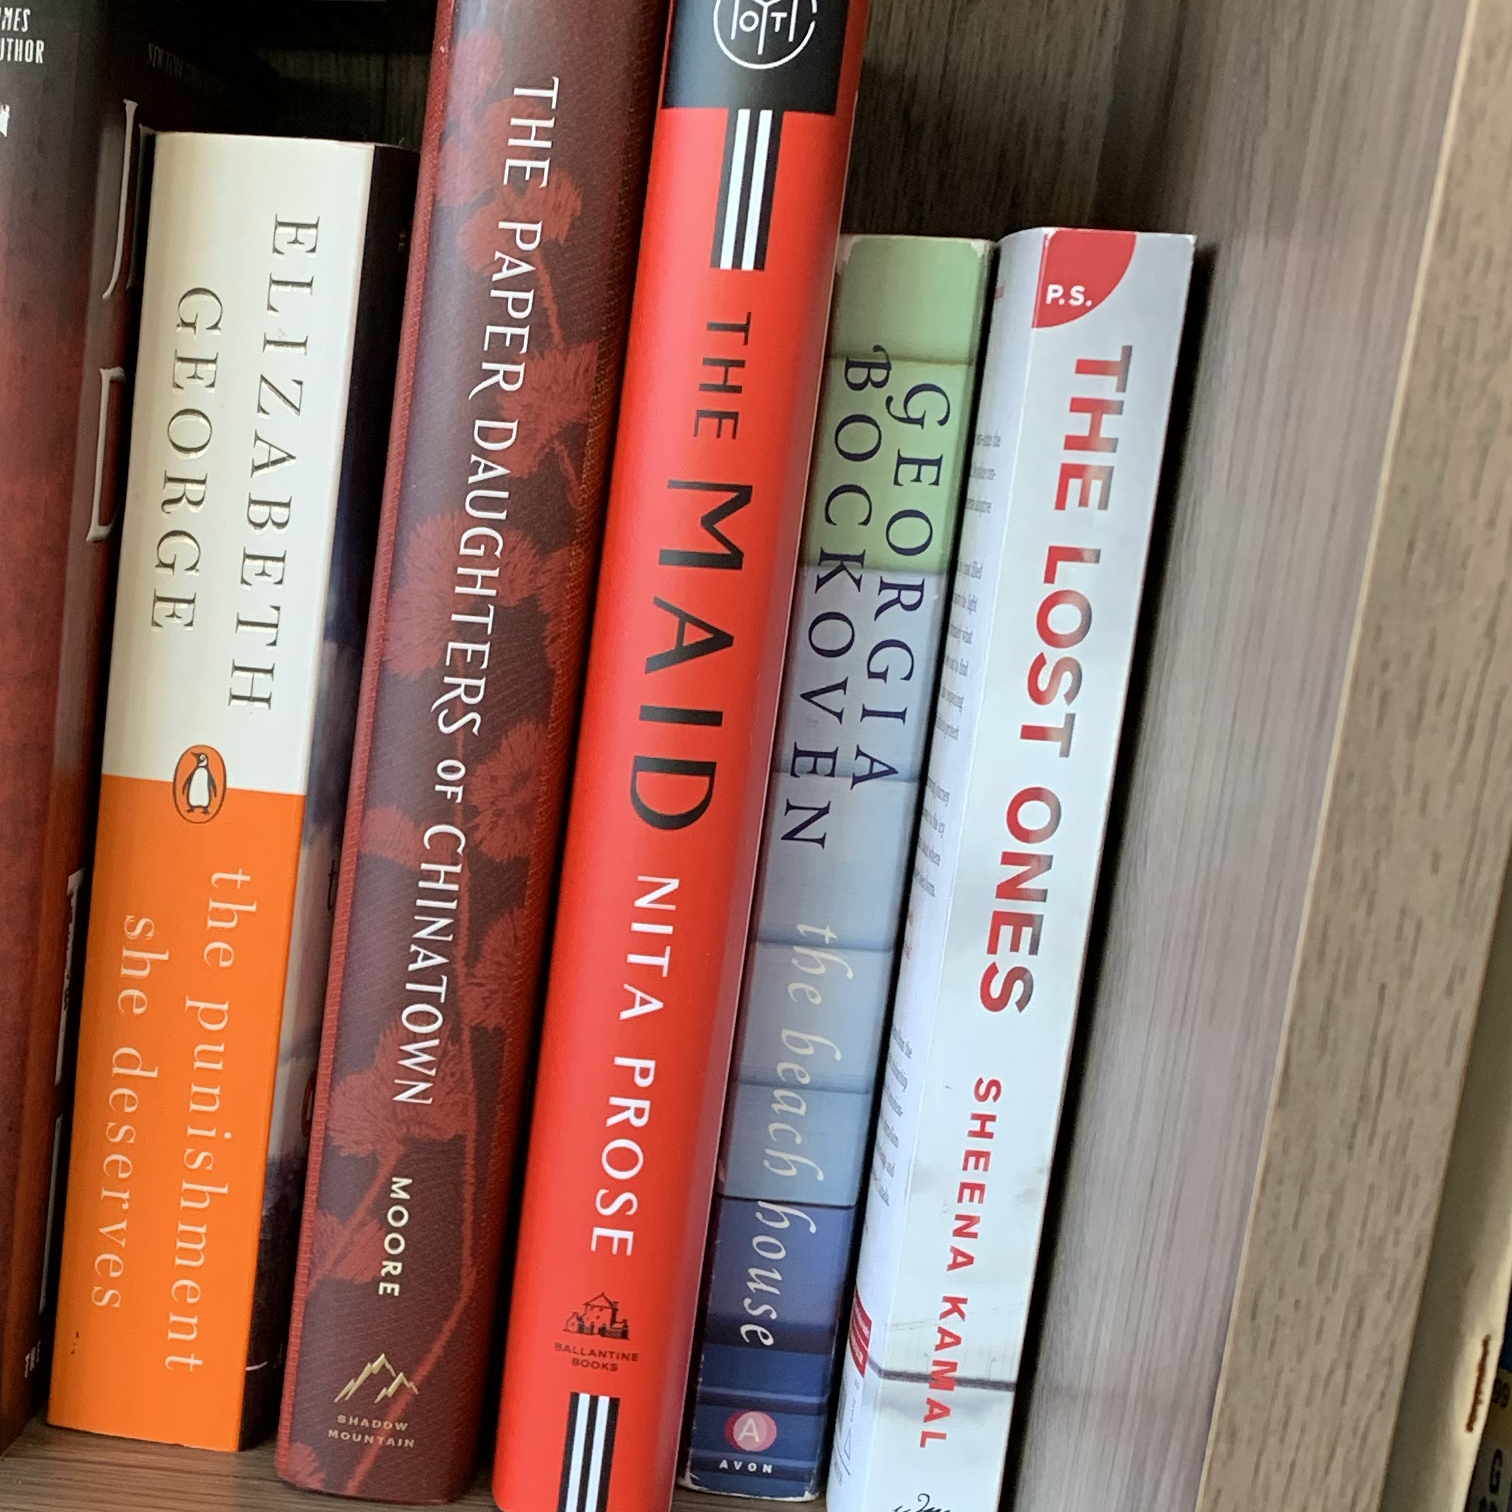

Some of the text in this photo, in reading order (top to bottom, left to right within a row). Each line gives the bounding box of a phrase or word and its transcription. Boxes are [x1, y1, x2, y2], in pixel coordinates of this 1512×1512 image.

[151, 286, 224, 631] GEORGE
[227, 213, 320, 709] ELIZABETH
[1045, 282, 1093, 309] P.S.
[392, 75, 561, 1107] THE PAPER DAUGHTERS OF CHINATOWN
[630, 310, 754, 833] THE MAID
[780, 343, 893, 850] BOCKOVEN
[849, 381, 951, 791] GEORGIA
[979, 344, 1134, 1015] THE LOST ONES
[377, 1174, 414, 1298] MOORE
[553, 1340, 640, 1363] BALLANTINE
[571, 1355, 620, 1373] BOOKS
[919, 1076, 1002, 1449] SHEENA KAMAL
[327, 1428, 417, 1450] MOUNTAIN
[336, 1412, 410, 1434] SHADOW
[719, 1458, 774, 1474] AVON
